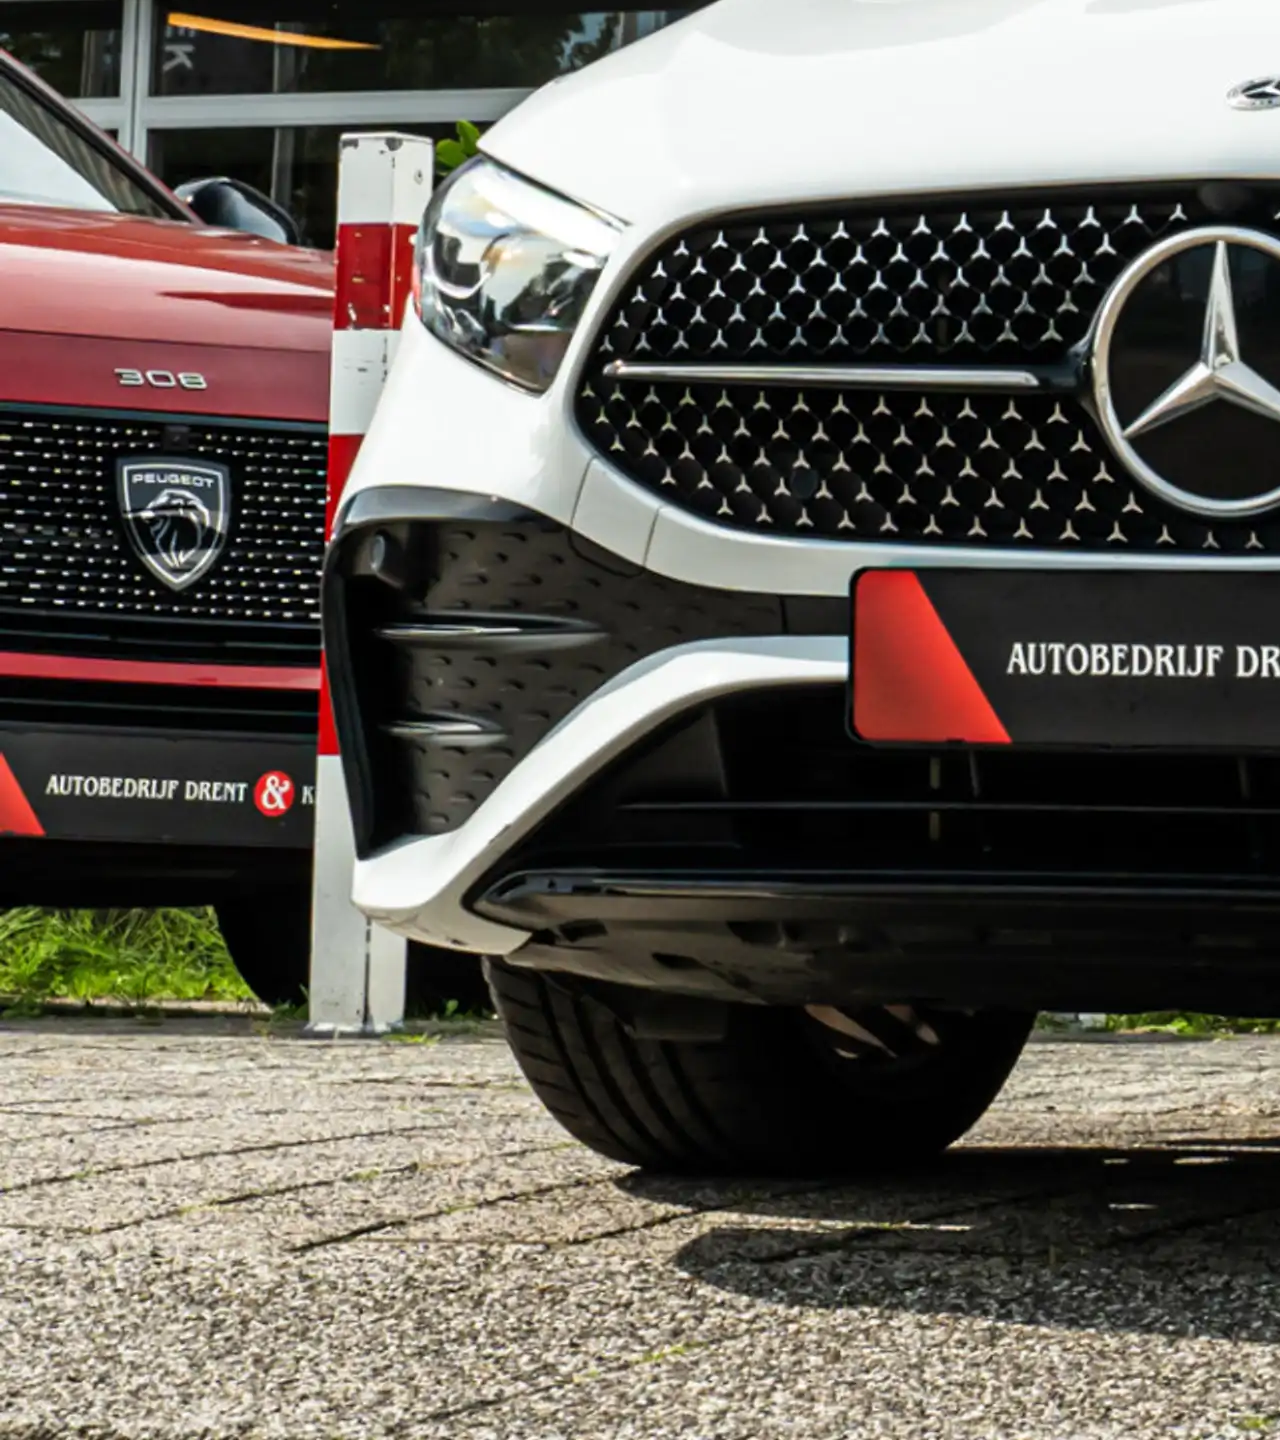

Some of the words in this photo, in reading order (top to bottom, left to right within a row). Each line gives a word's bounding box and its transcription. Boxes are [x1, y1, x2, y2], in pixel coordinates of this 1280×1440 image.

[114, 368, 208, 389] 308
[131, 472, 214, 488] PEUGEOT
[1006, 642, 1224, 679] AUTOBEDRIJF
[45, 774, 179, 800] AUTOBEDRIJF
[184, 780, 248, 803] DRENT
[261, 775, 290, 810] &
[301, 785, 317, 805] K
